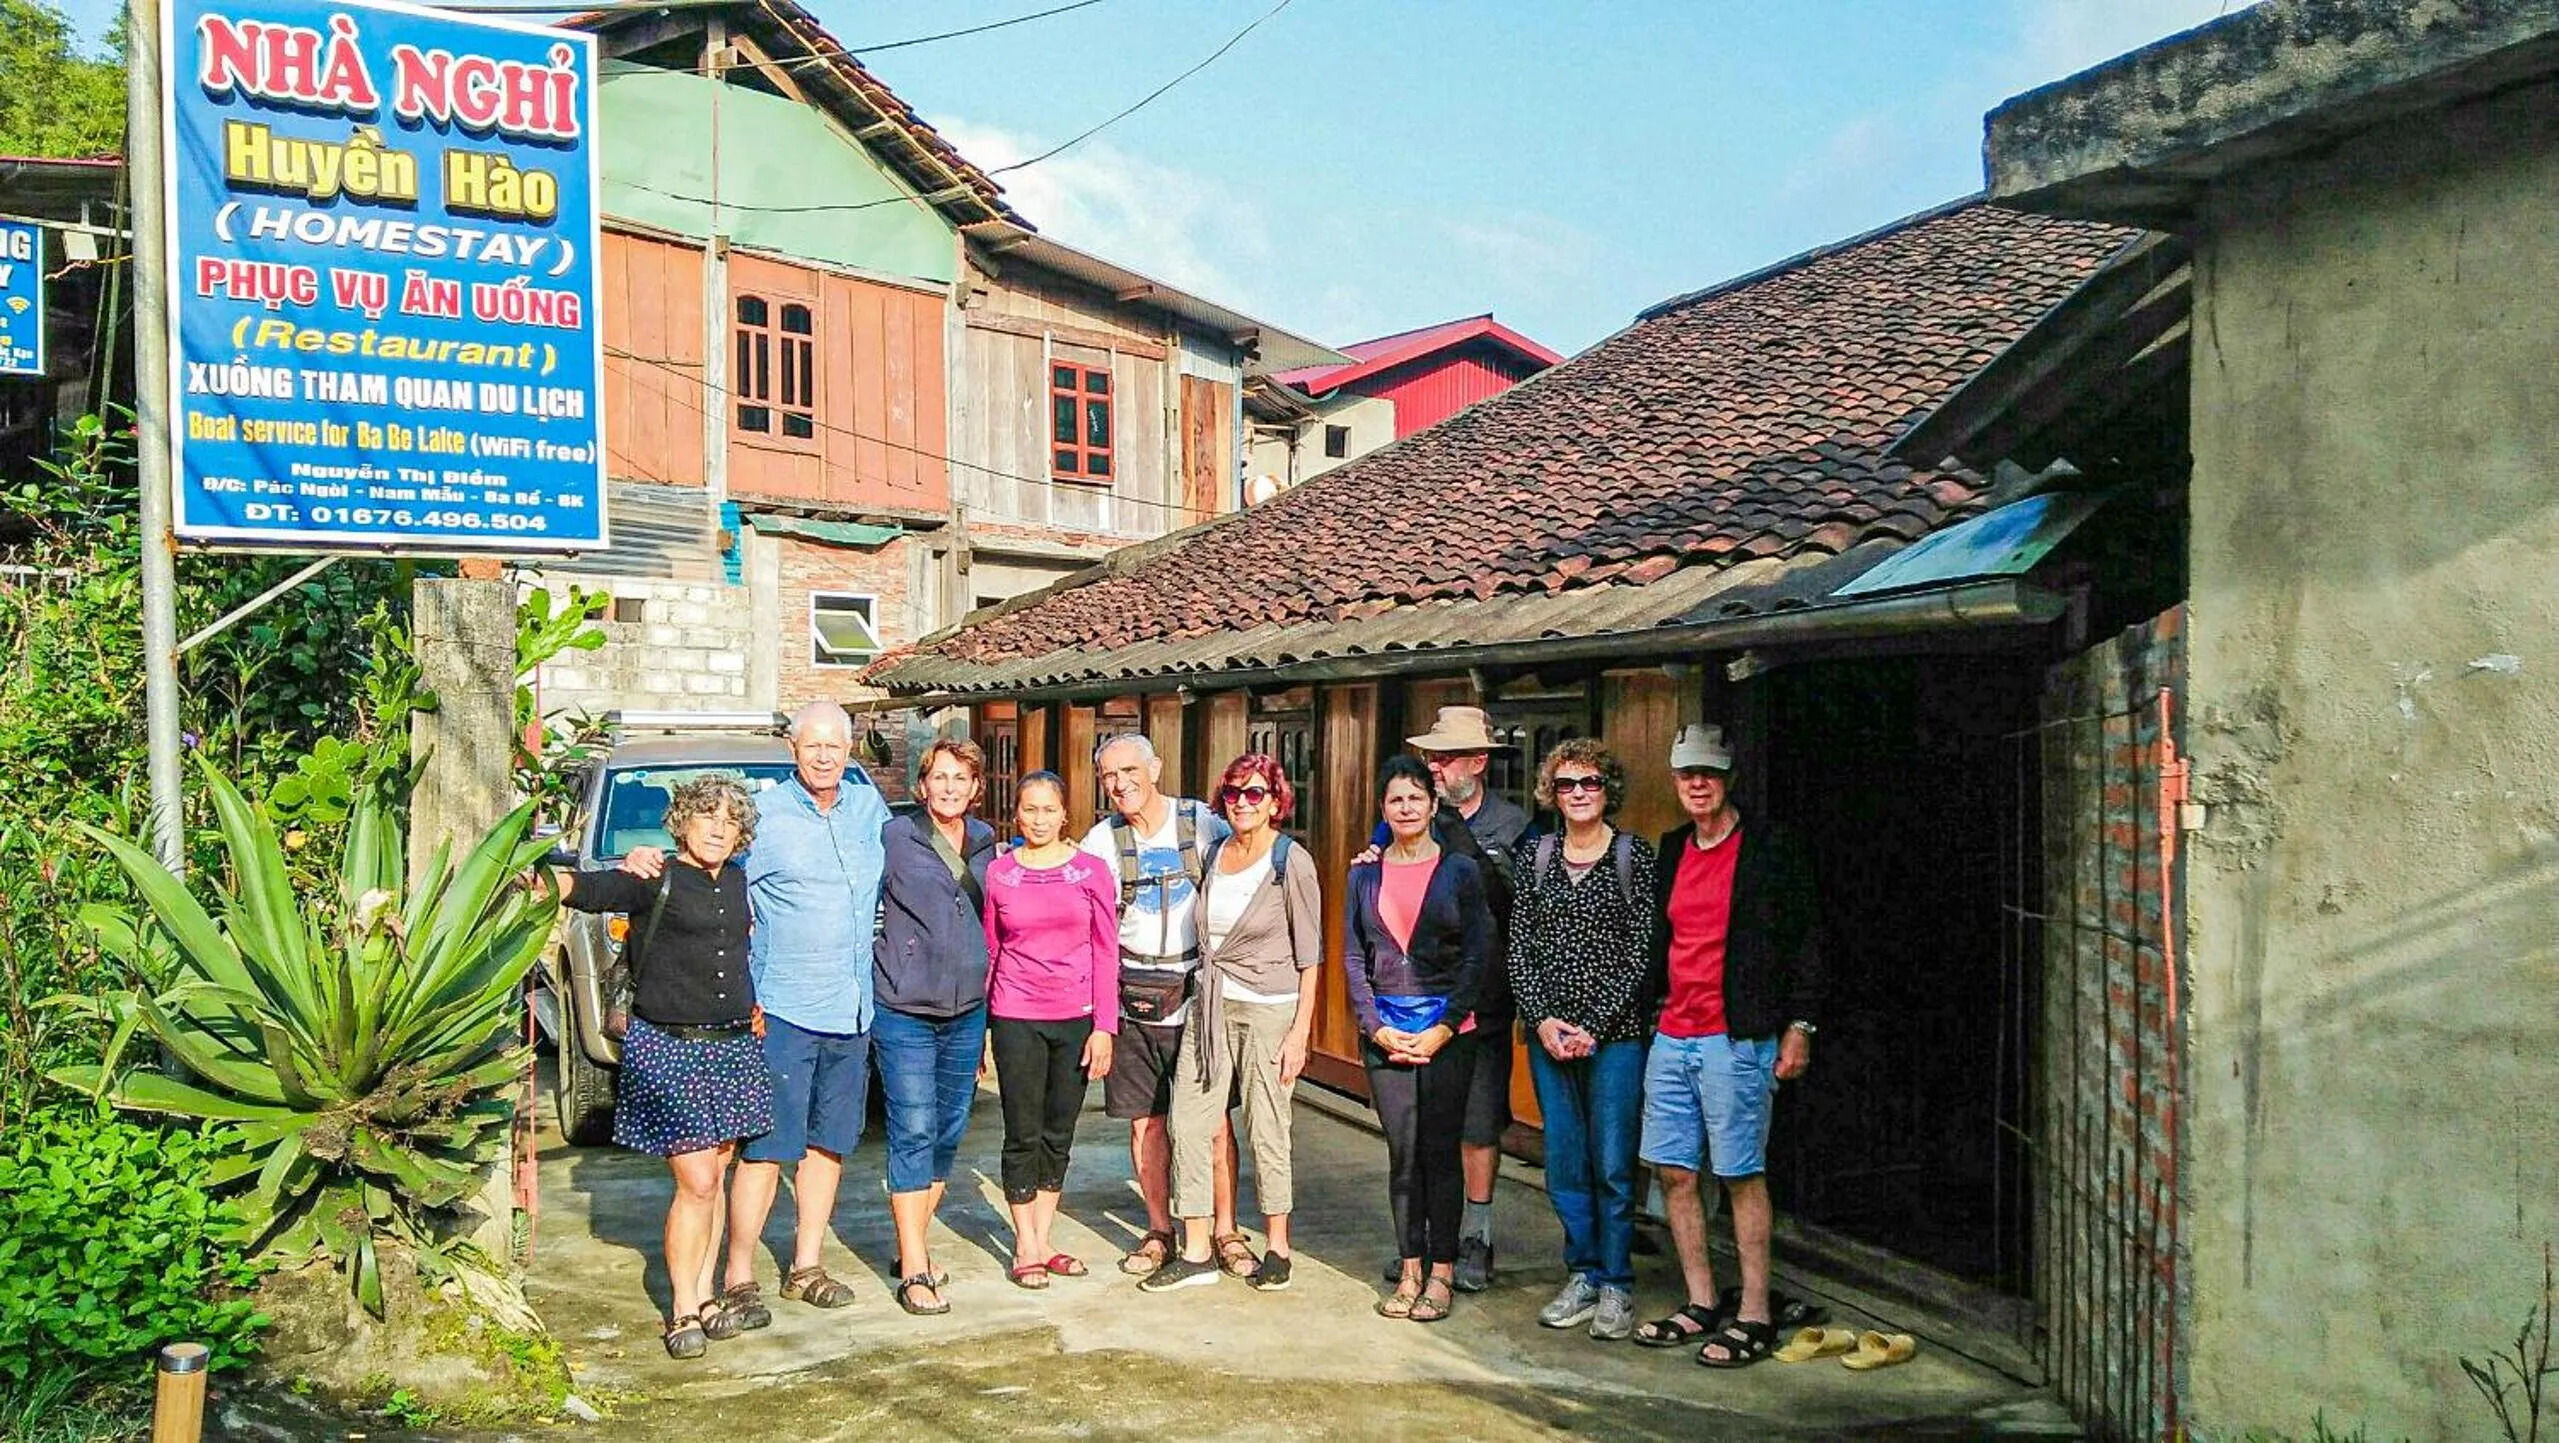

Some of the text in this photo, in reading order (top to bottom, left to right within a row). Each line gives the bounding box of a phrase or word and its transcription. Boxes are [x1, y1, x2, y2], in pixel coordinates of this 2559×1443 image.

[200, 14, 580, 137] NHÀ NGHỈ
[225, 123, 557, 215] Huyền Hào
[196, 256, 581, 328] PHỤC VỤ ĂN UỐNG
[188, 354, 584, 422] XUỒNG THAM QUAN DU LỊCH
[188, 411, 236, 441] Boat
[242, 418, 317, 446] service
[322, 418, 350, 447] for
[357, 421, 383, 449] Ba
[387, 423, 412, 451] Be
[418, 425, 465, 454] Lake
[311, 506, 547, 531] 01676.496.504
[370, 485, 416, 500] Nam
[484, 490, 511, 505] Ba
